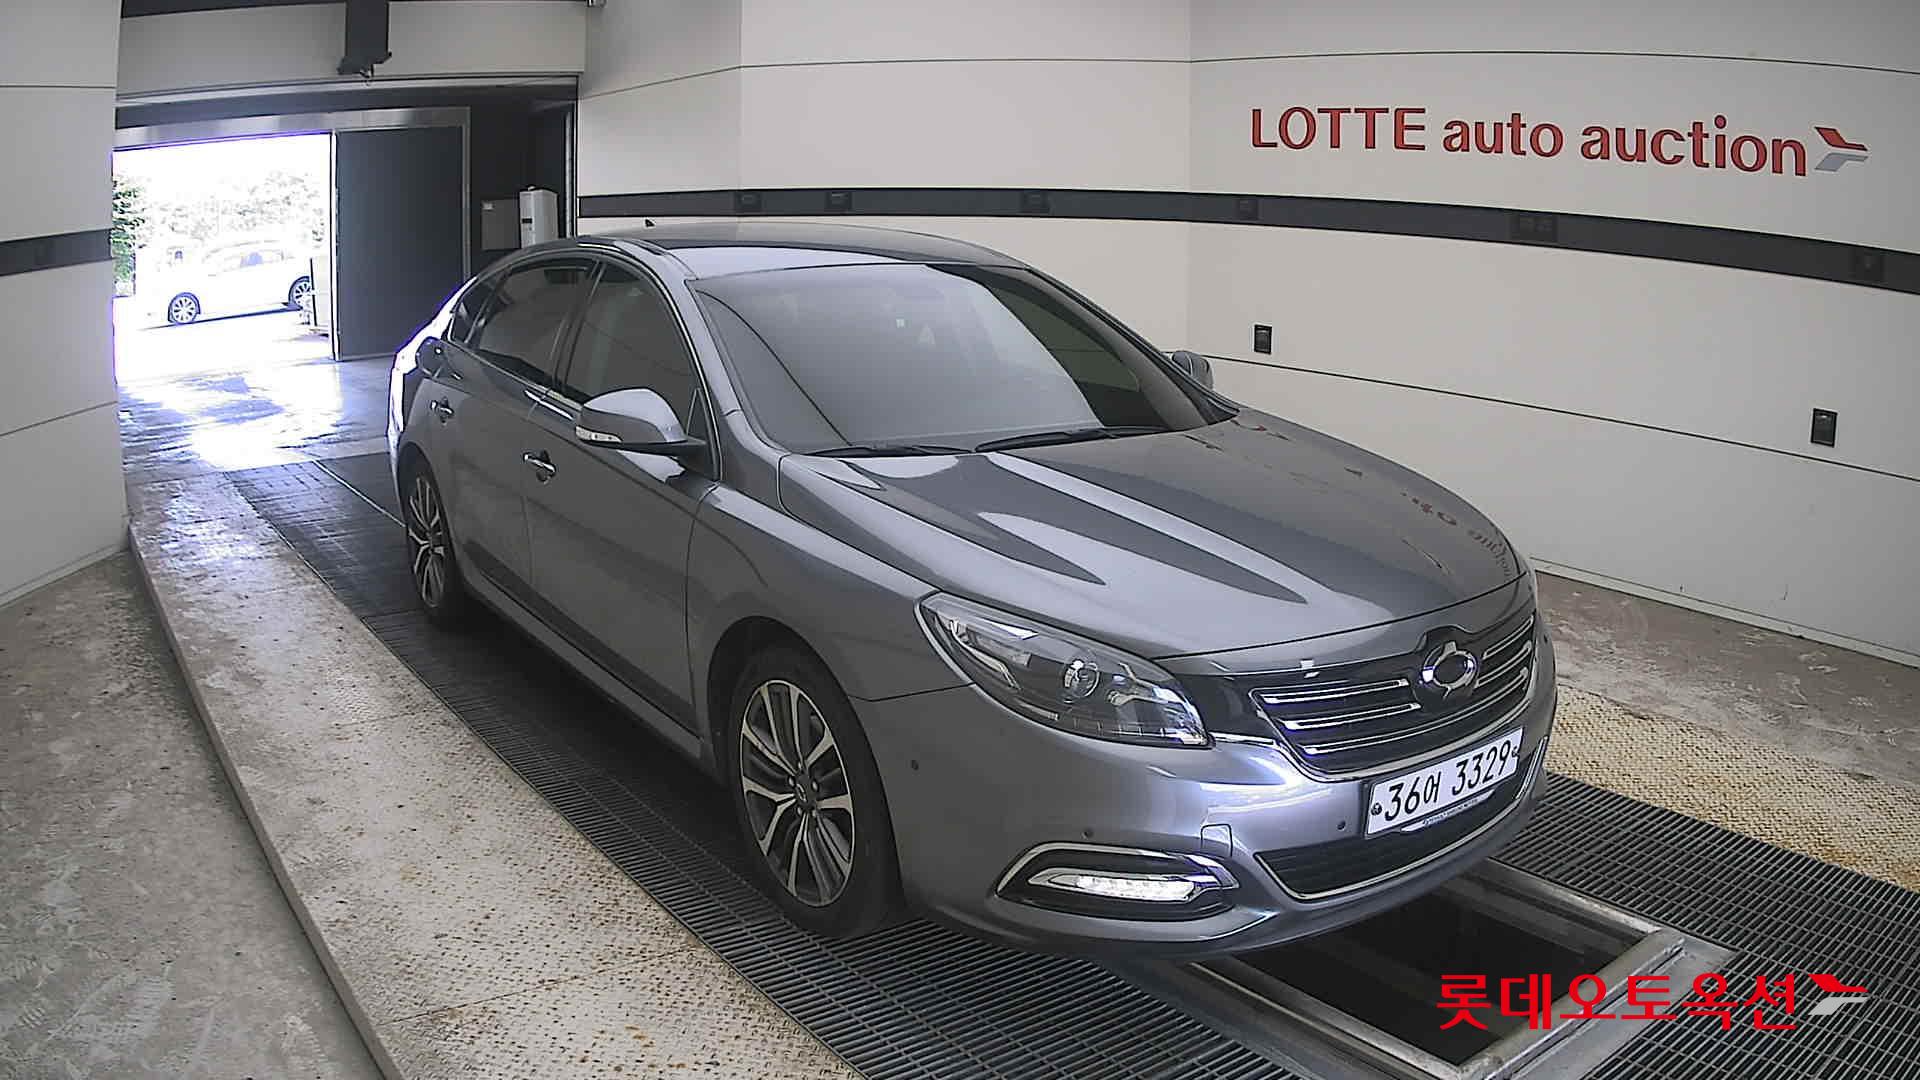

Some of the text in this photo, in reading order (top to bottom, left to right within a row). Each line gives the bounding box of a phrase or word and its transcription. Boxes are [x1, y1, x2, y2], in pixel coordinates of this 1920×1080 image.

[1252, 106, 1807, 177] LOTTE auto auction
[1384, 771, 1442, 821] 36어
[1451, 740, 1511, 796] 3329
